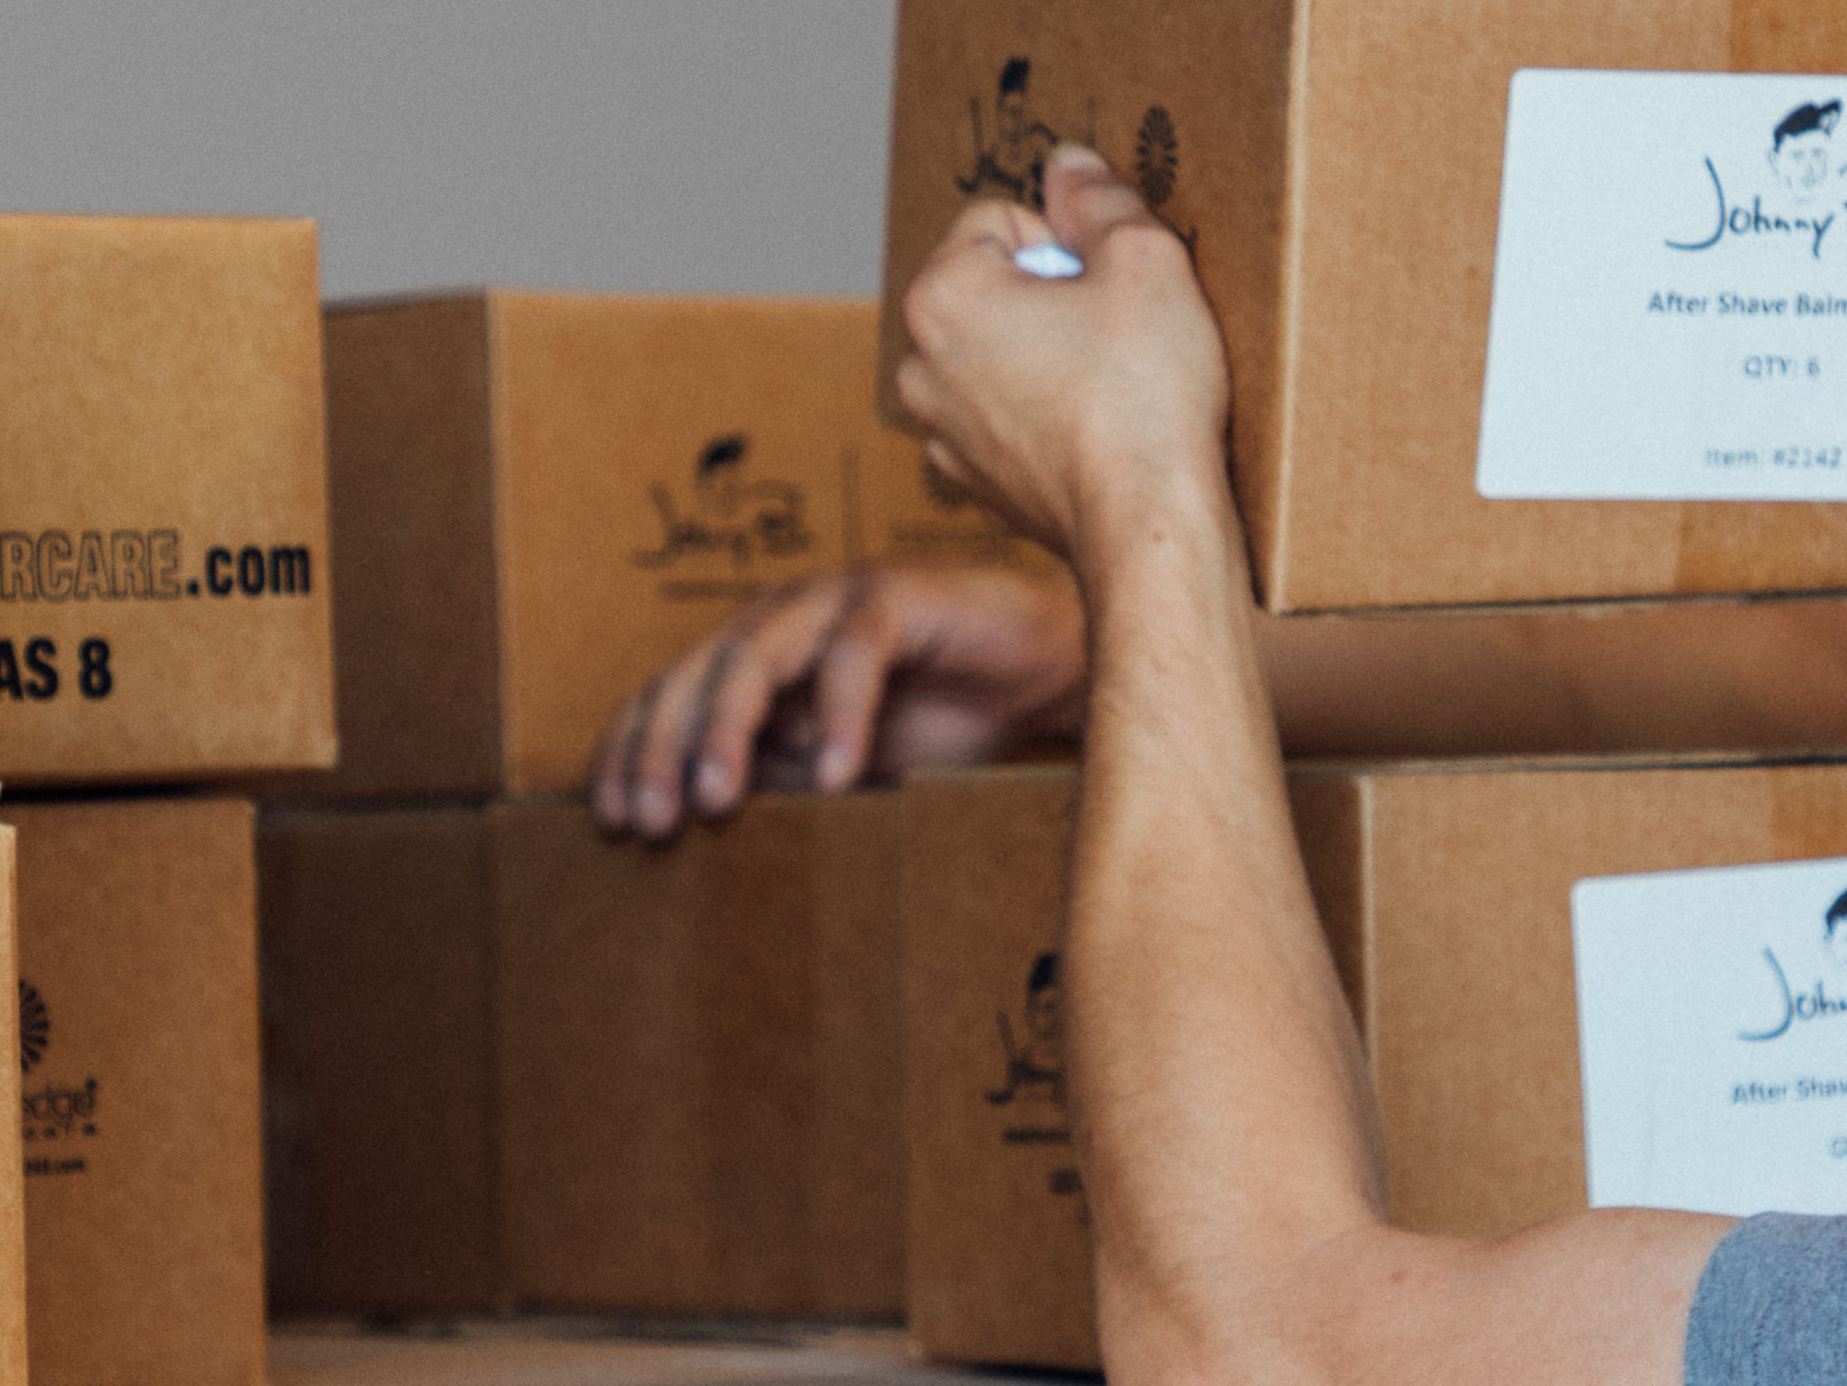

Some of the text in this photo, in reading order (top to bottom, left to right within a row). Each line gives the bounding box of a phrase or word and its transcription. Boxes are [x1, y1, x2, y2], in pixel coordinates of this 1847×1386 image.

[1664, 155, 1835, 259] Johnny
[1647, 289, 1710, 316] After
[1717, 291, 1788, 317] Shave
[1742, 355, 1821, 380] QTY: 6
[1703, 445, 1760, 468] Item:
[78, 636, 113, 702] 8
[1732, 1078, 1788, 1105] After
